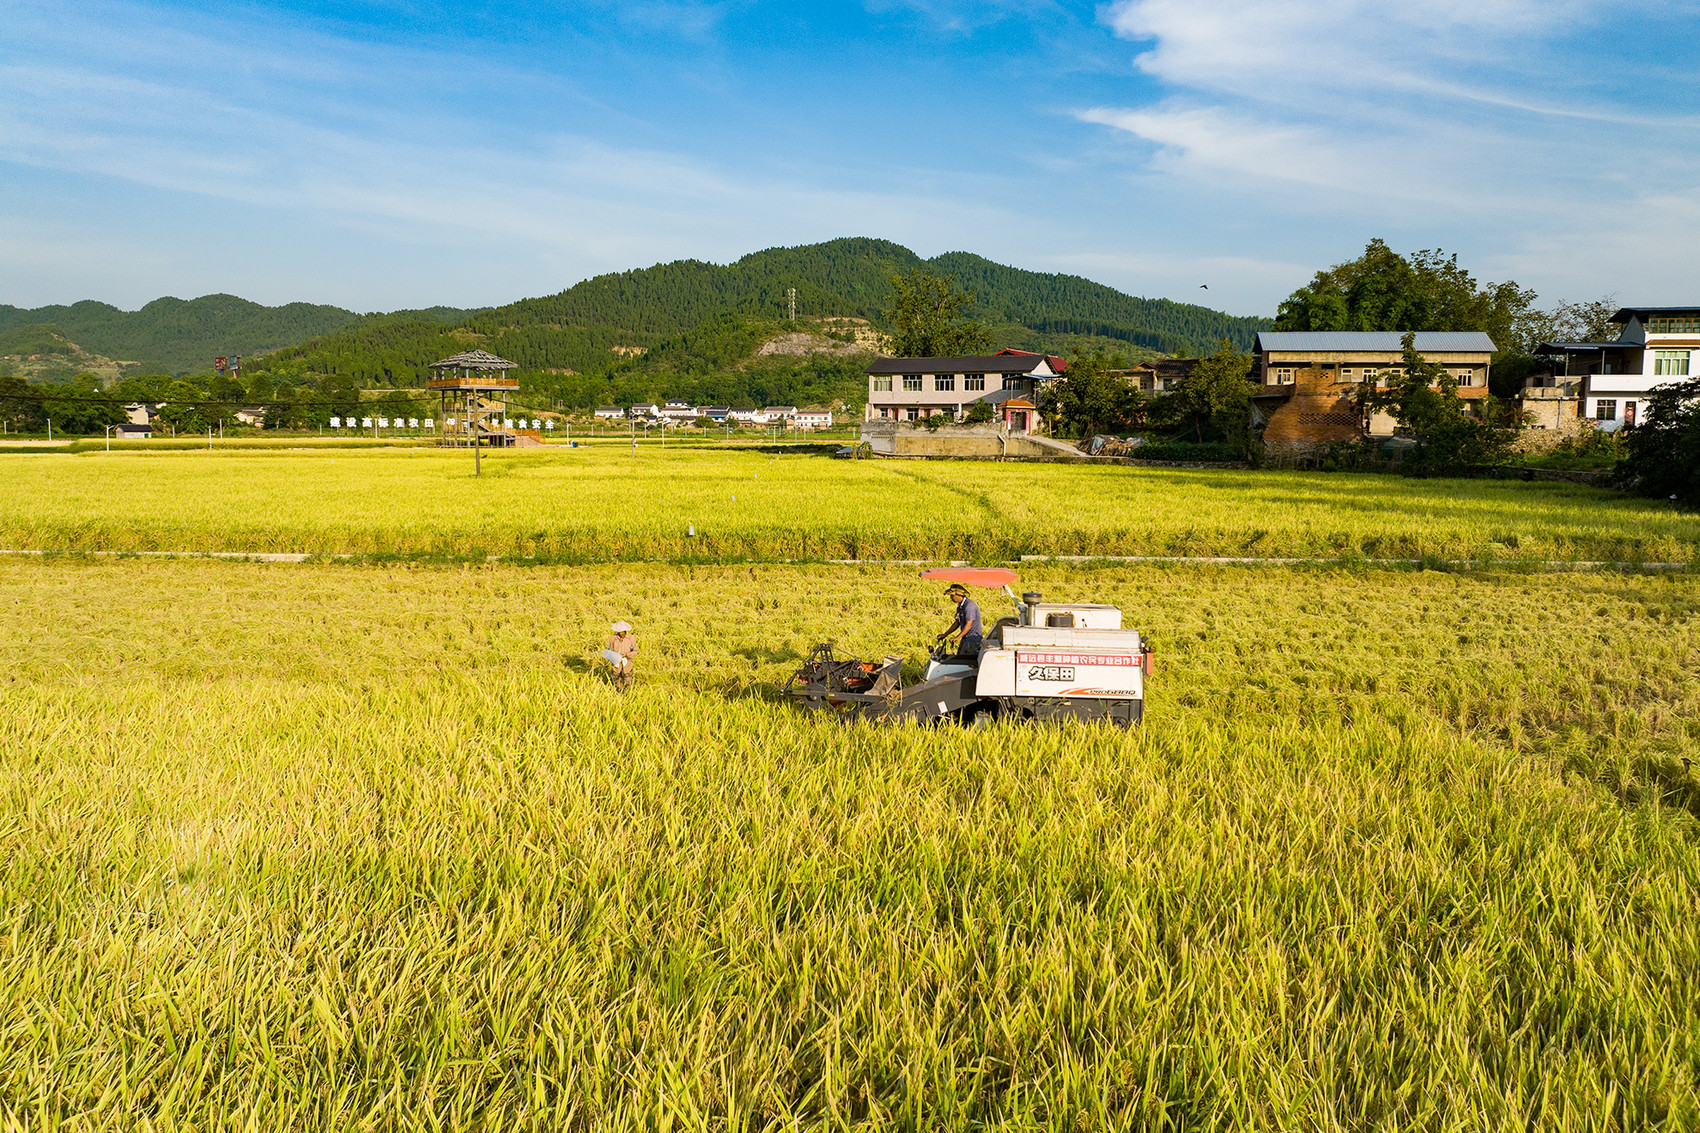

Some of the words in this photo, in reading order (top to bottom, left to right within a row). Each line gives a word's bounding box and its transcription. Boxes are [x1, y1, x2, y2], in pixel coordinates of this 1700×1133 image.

[330, 417, 434, 428] 建设高标准农田
[1028, 666, 1075, 682] 久保田
